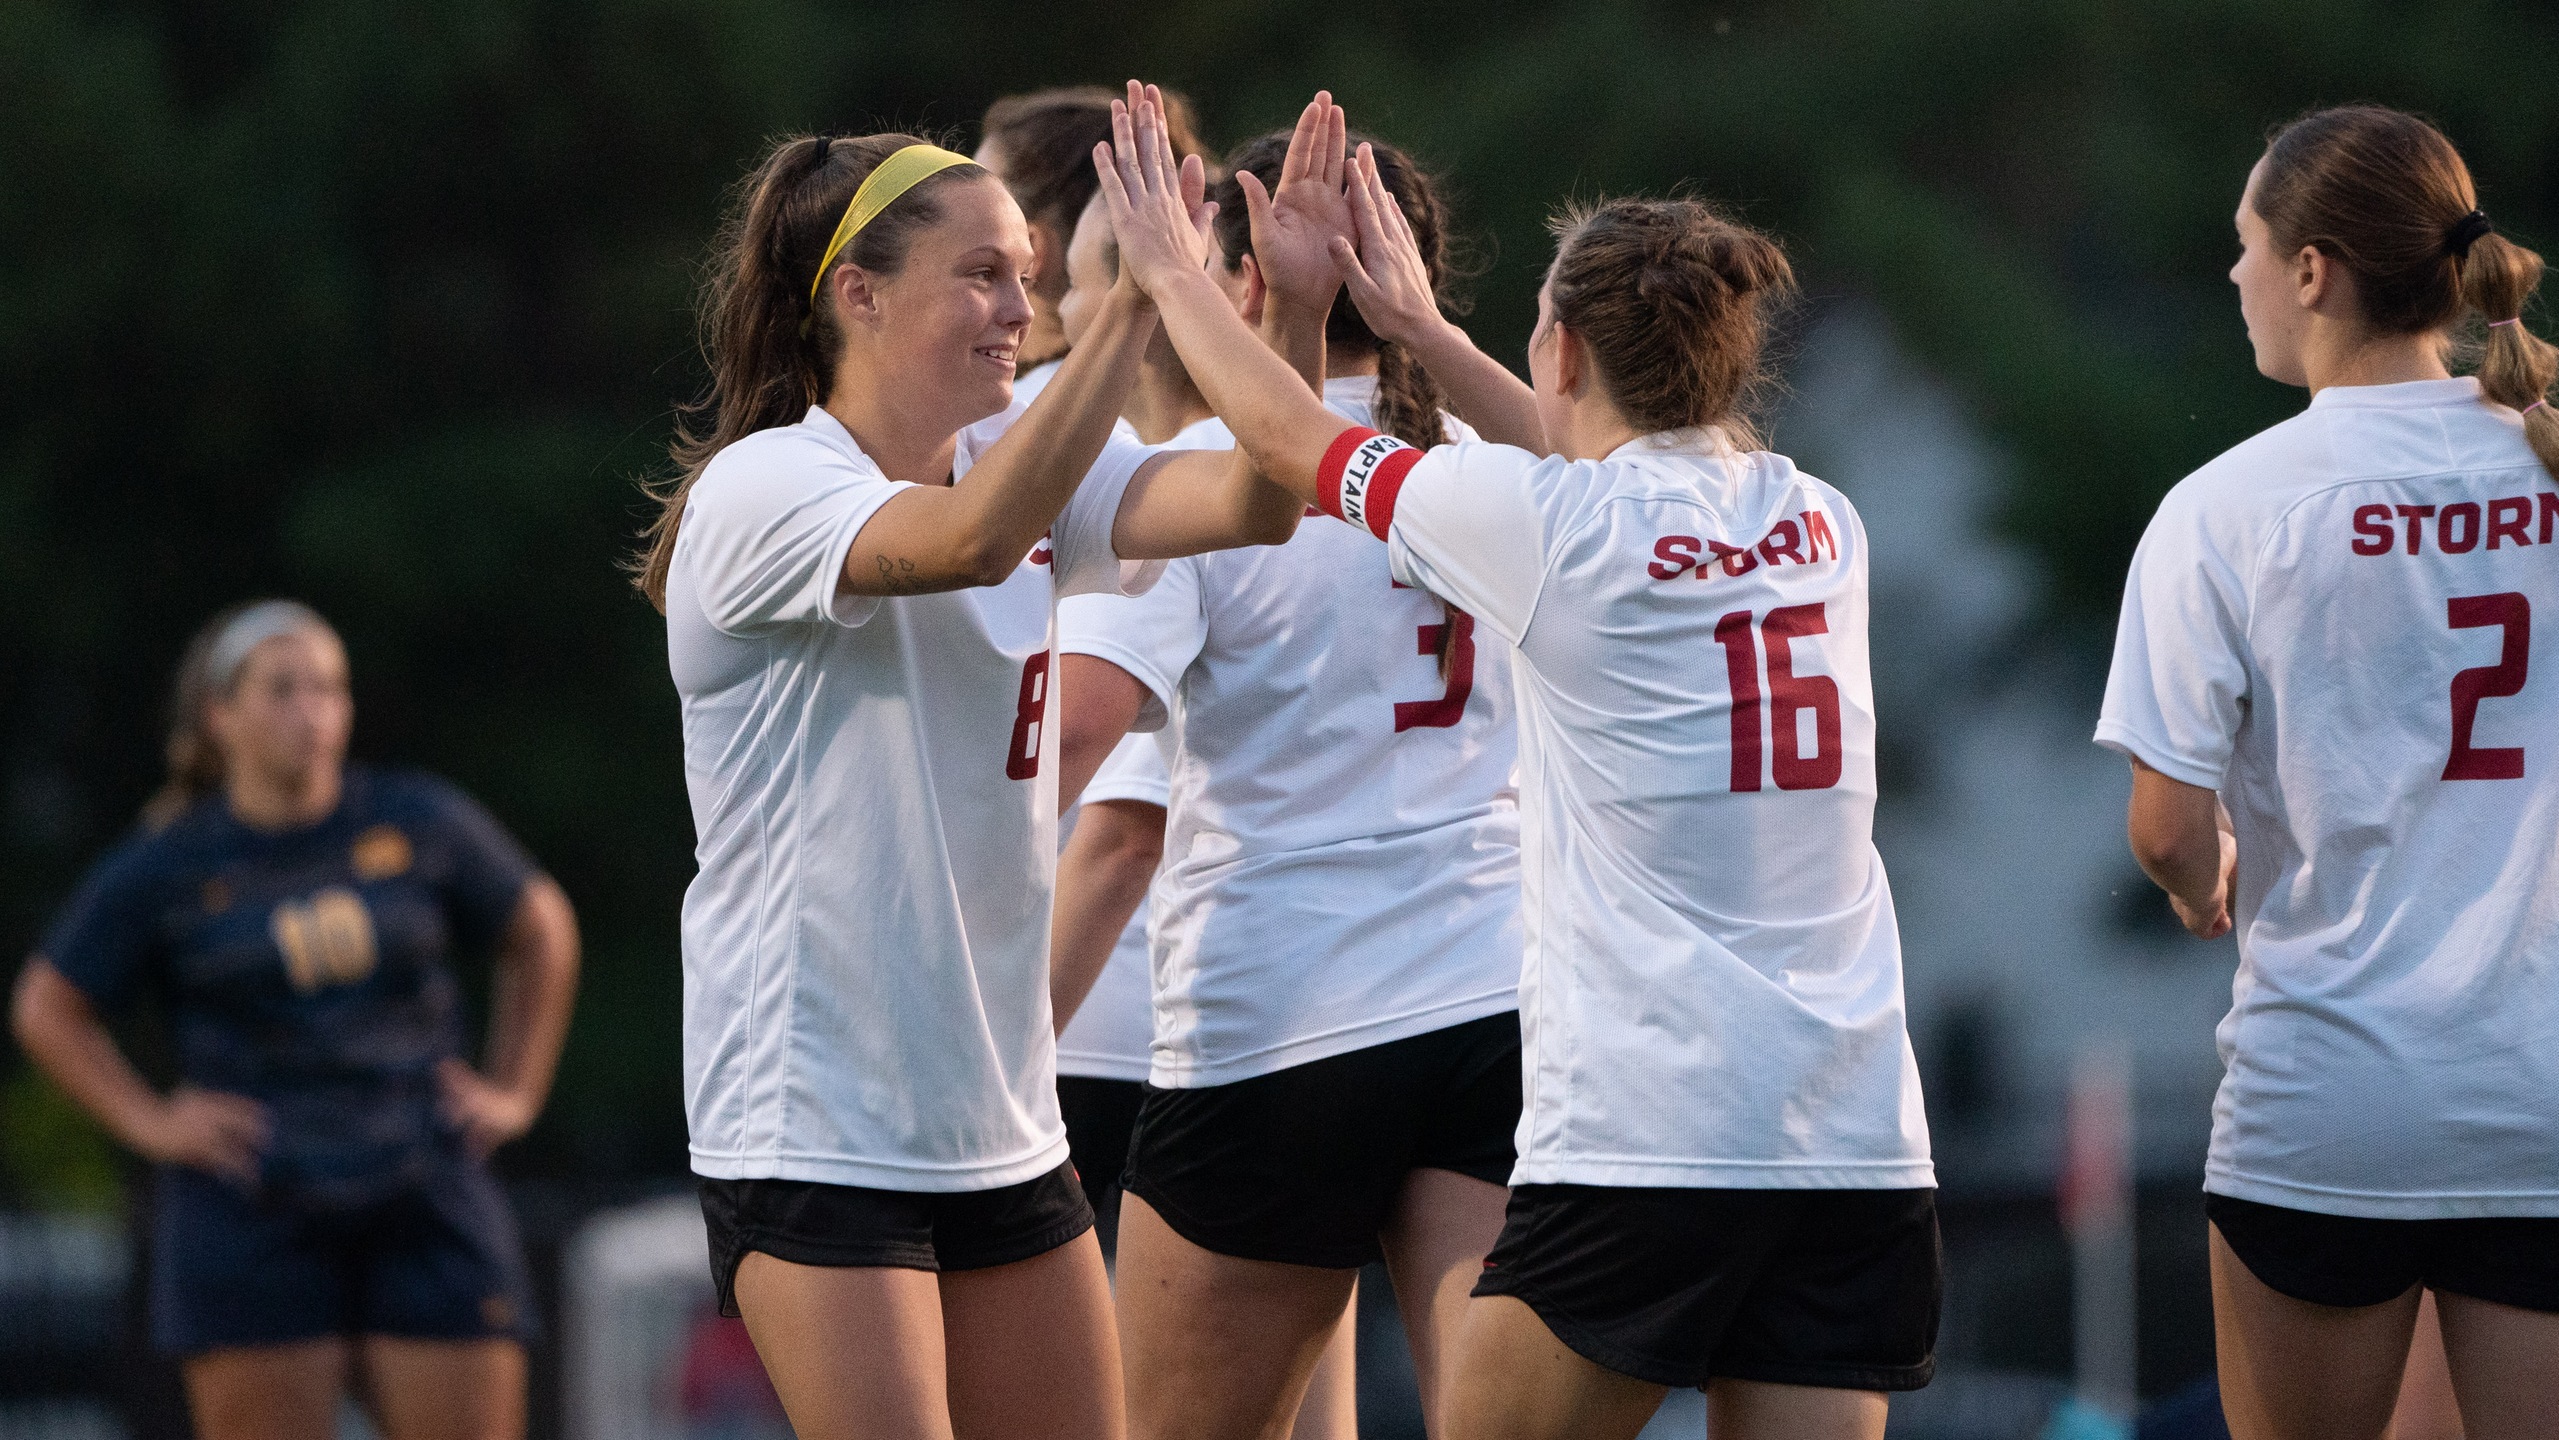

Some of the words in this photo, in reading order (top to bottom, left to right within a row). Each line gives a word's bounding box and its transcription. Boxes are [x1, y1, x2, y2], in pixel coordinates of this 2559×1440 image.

[1345, 437, 1400, 524] CAPTAIN
[1647, 510, 1837, 580] STORM
[1006, 648, 1050, 780] 8
[1391, 577, 1476, 734] 3
[1713, 602, 1843, 793] 16
[2440, 591, 2531, 781] 2
[270, 887, 378, 995] 10
